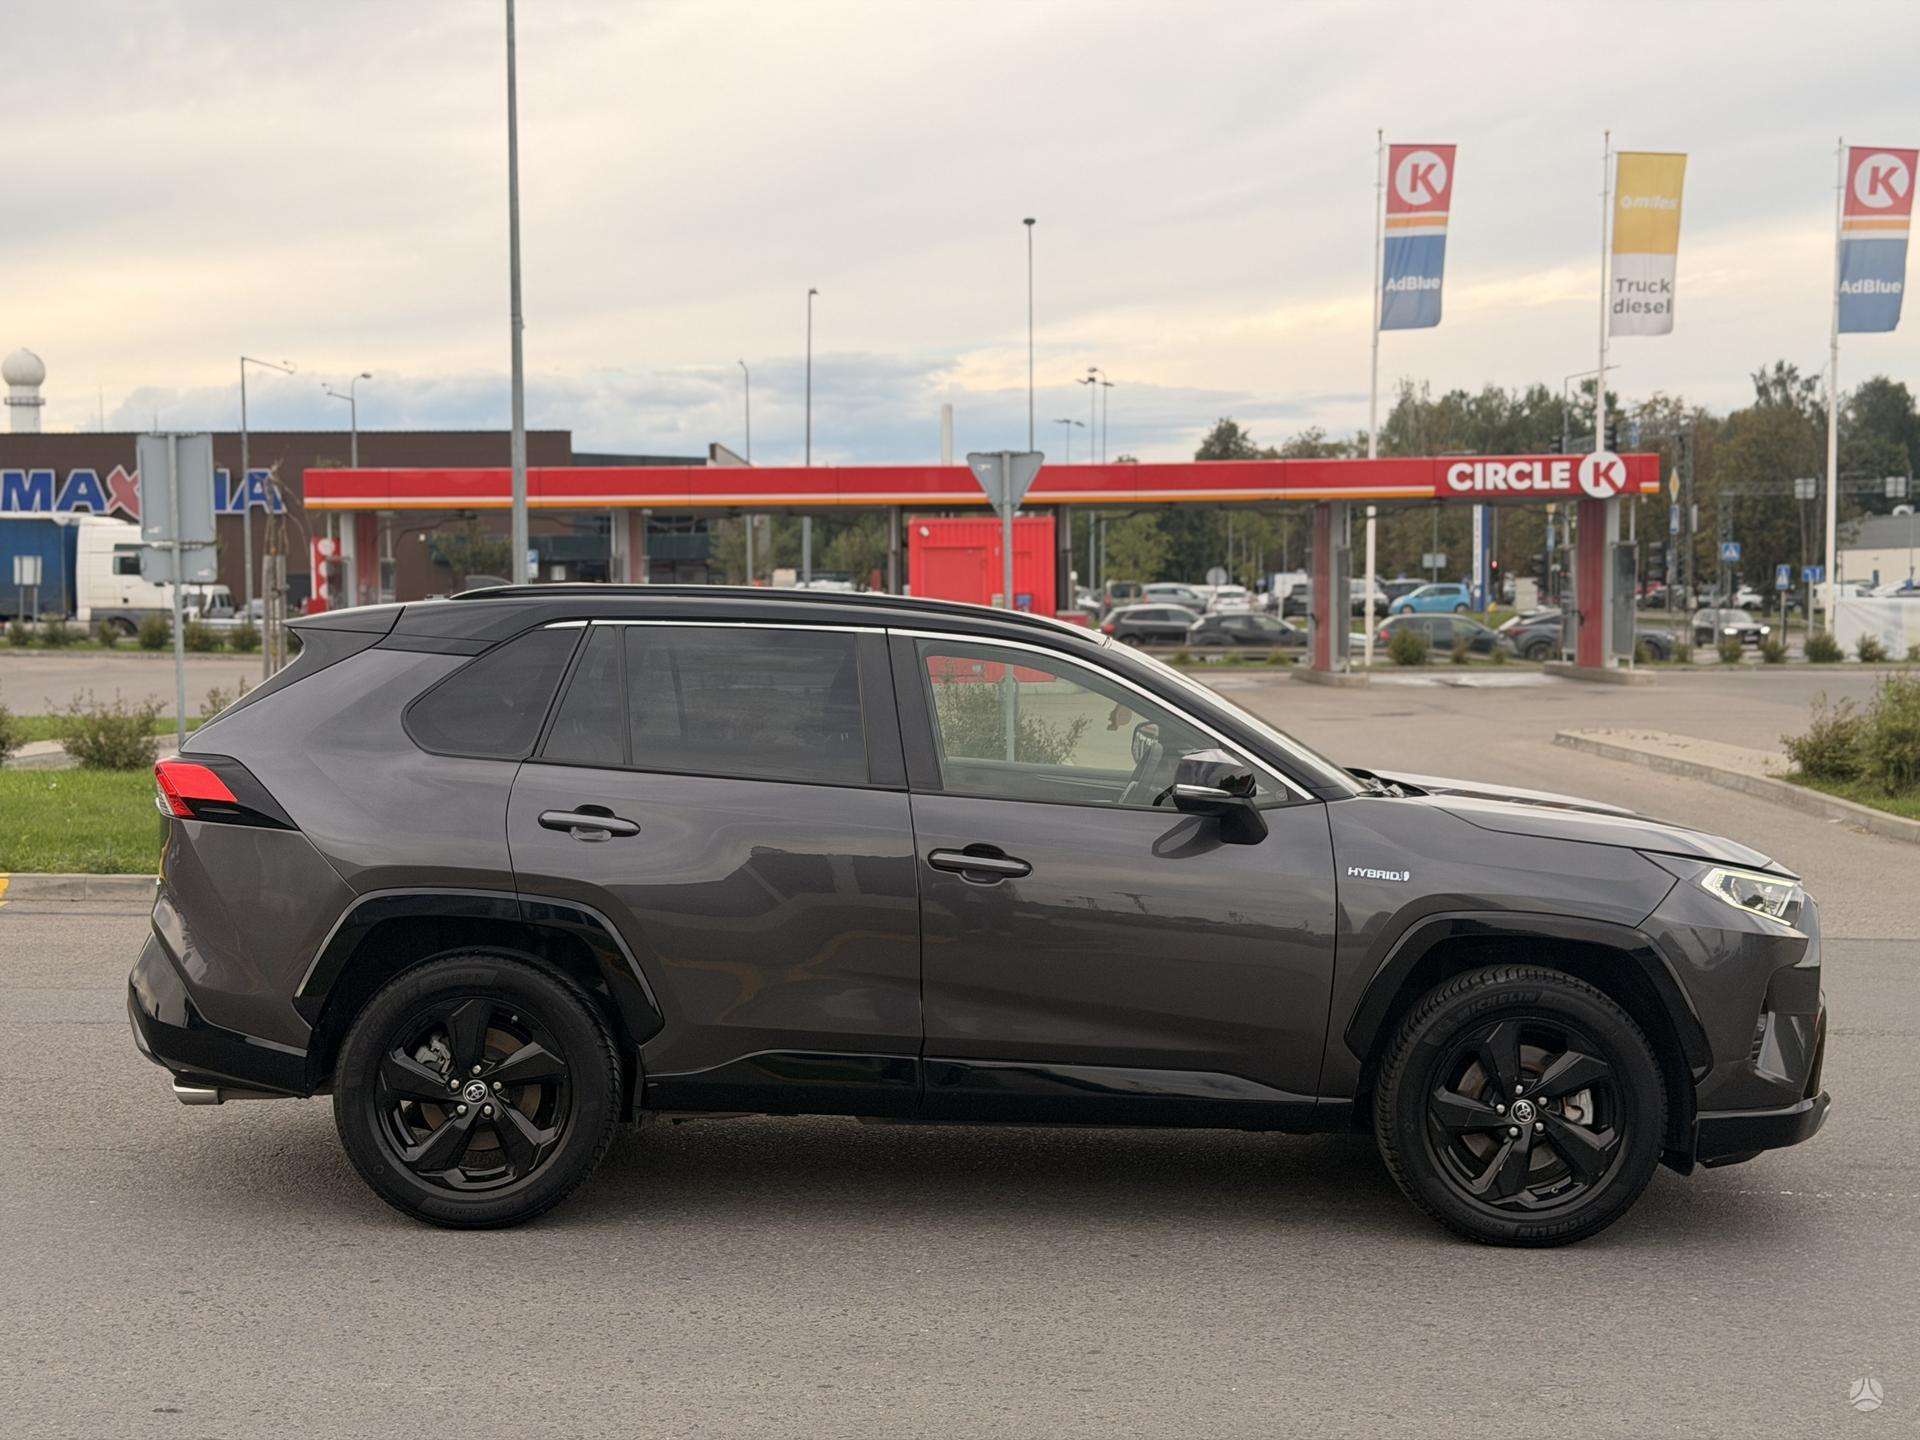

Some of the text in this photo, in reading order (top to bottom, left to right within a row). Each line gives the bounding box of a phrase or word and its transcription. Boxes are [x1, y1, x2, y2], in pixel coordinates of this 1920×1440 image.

[1386, 275, 1441, 292] AdBlue
[1616, 278, 1672, 294] Truck
[1840, 278, 1902, 295] AdBlue
[1613, 298, 1671, 315] diesel
[1447, 461, 1571, 491] CIRCLE
[1347, 866, 1400, 881] HYBRID
